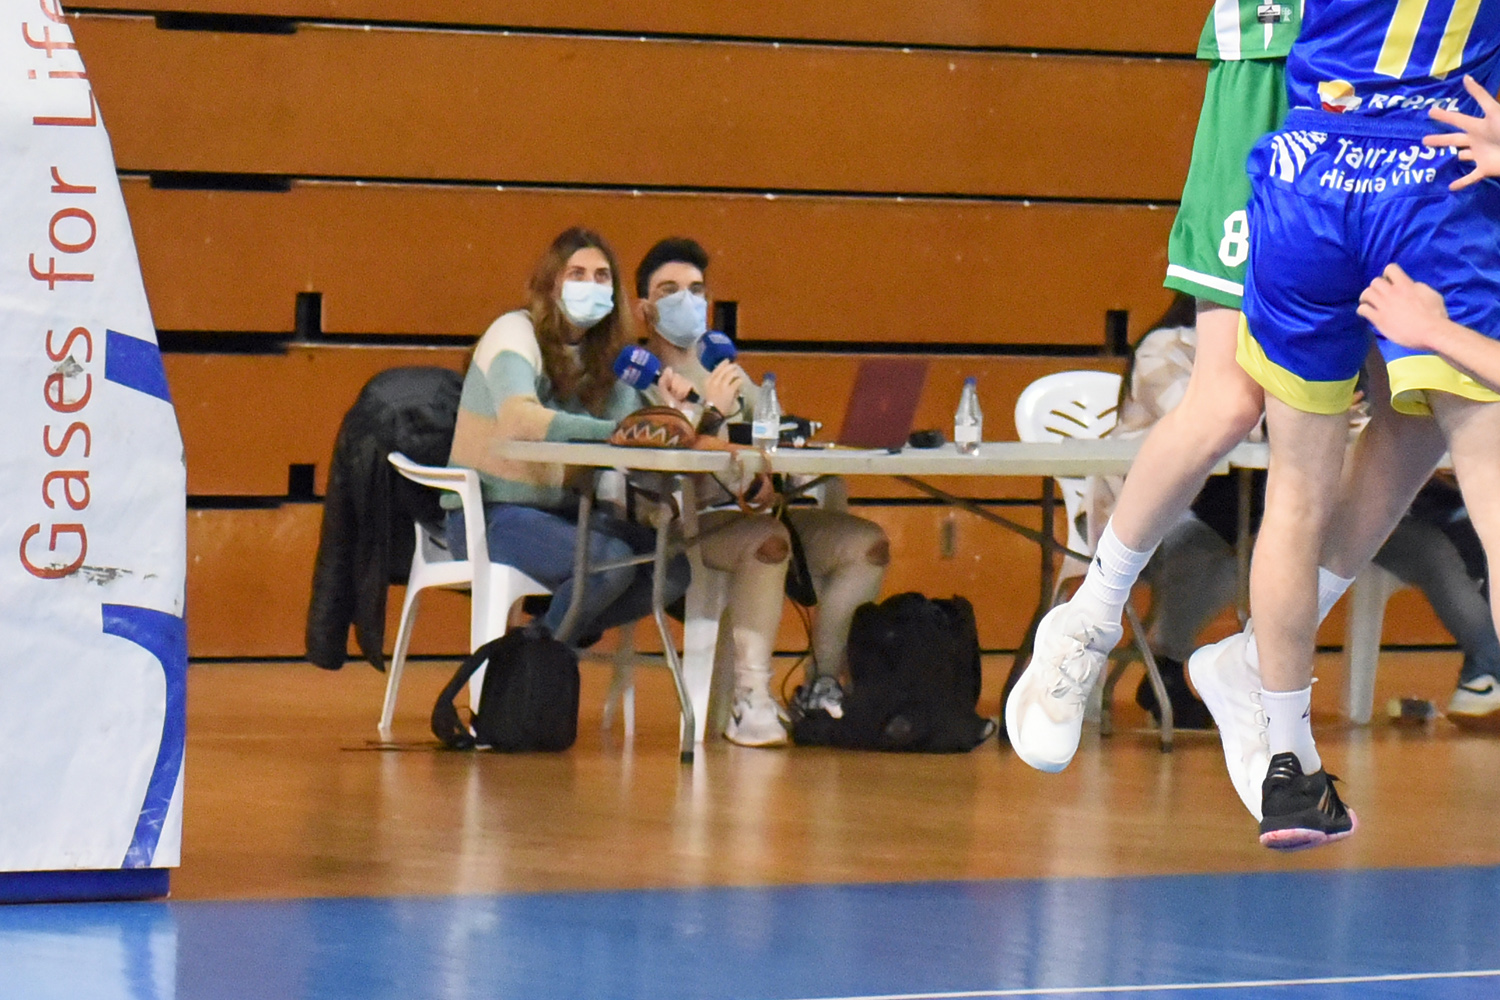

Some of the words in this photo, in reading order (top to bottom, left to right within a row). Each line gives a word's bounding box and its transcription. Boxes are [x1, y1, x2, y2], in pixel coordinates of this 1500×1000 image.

[29, 166, 97, 291] for
[1218, 209, 1250, 269] 8
[18, 326, 93, 580] Gases
